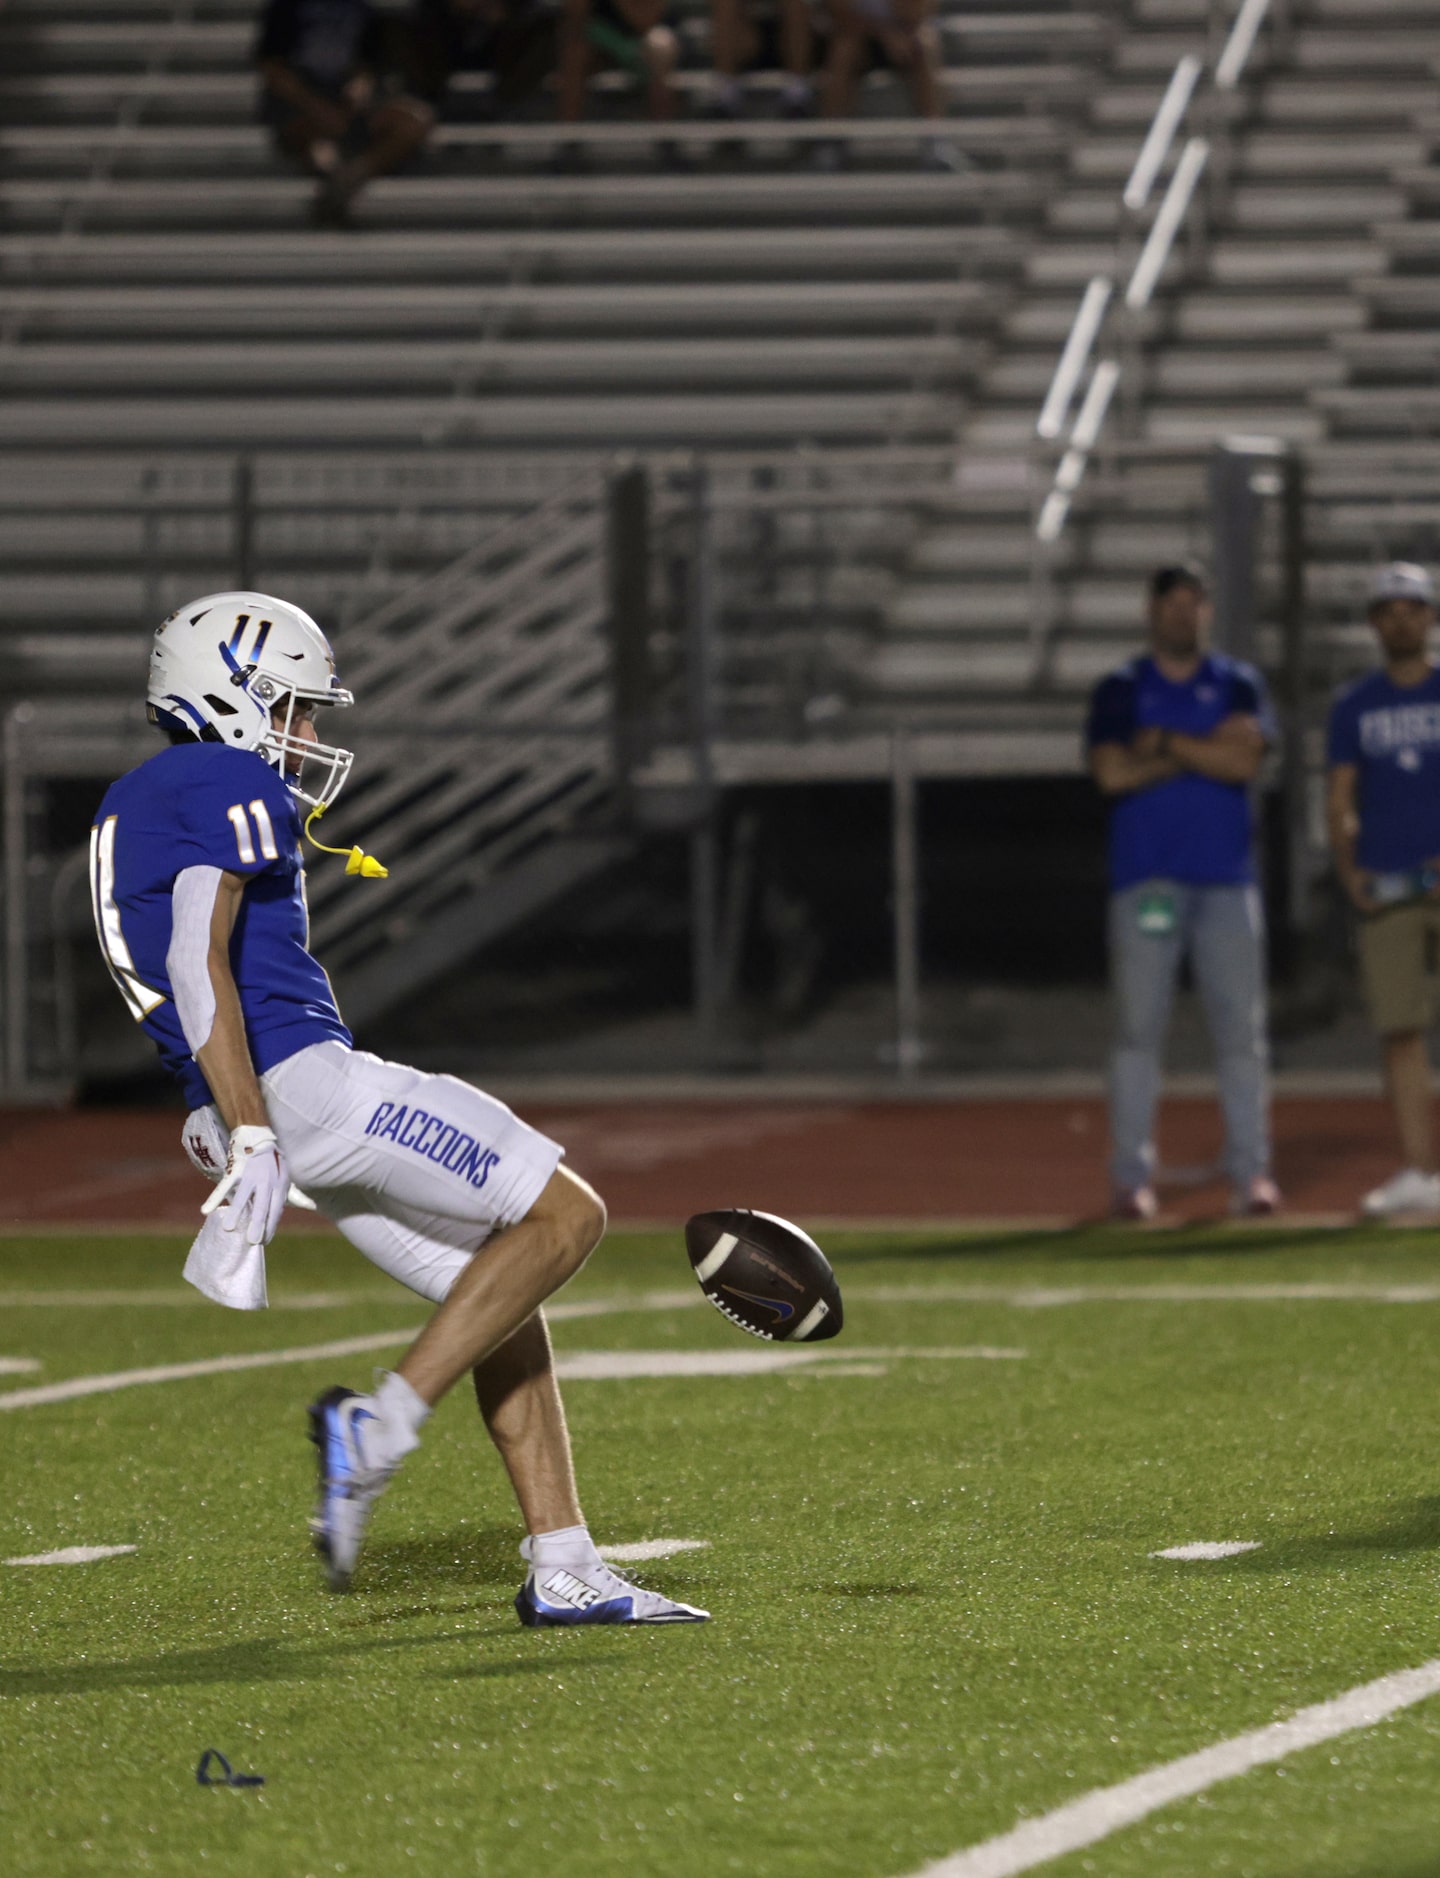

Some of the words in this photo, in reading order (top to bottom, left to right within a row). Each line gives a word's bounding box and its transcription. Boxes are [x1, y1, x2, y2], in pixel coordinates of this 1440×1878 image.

[224, 614, 273, 665] 11
[227, 799, 279, 864] 11
[364, 1101, 501, 1189] RACCOONS
[542, 1568, 602, 1613] NIKE
